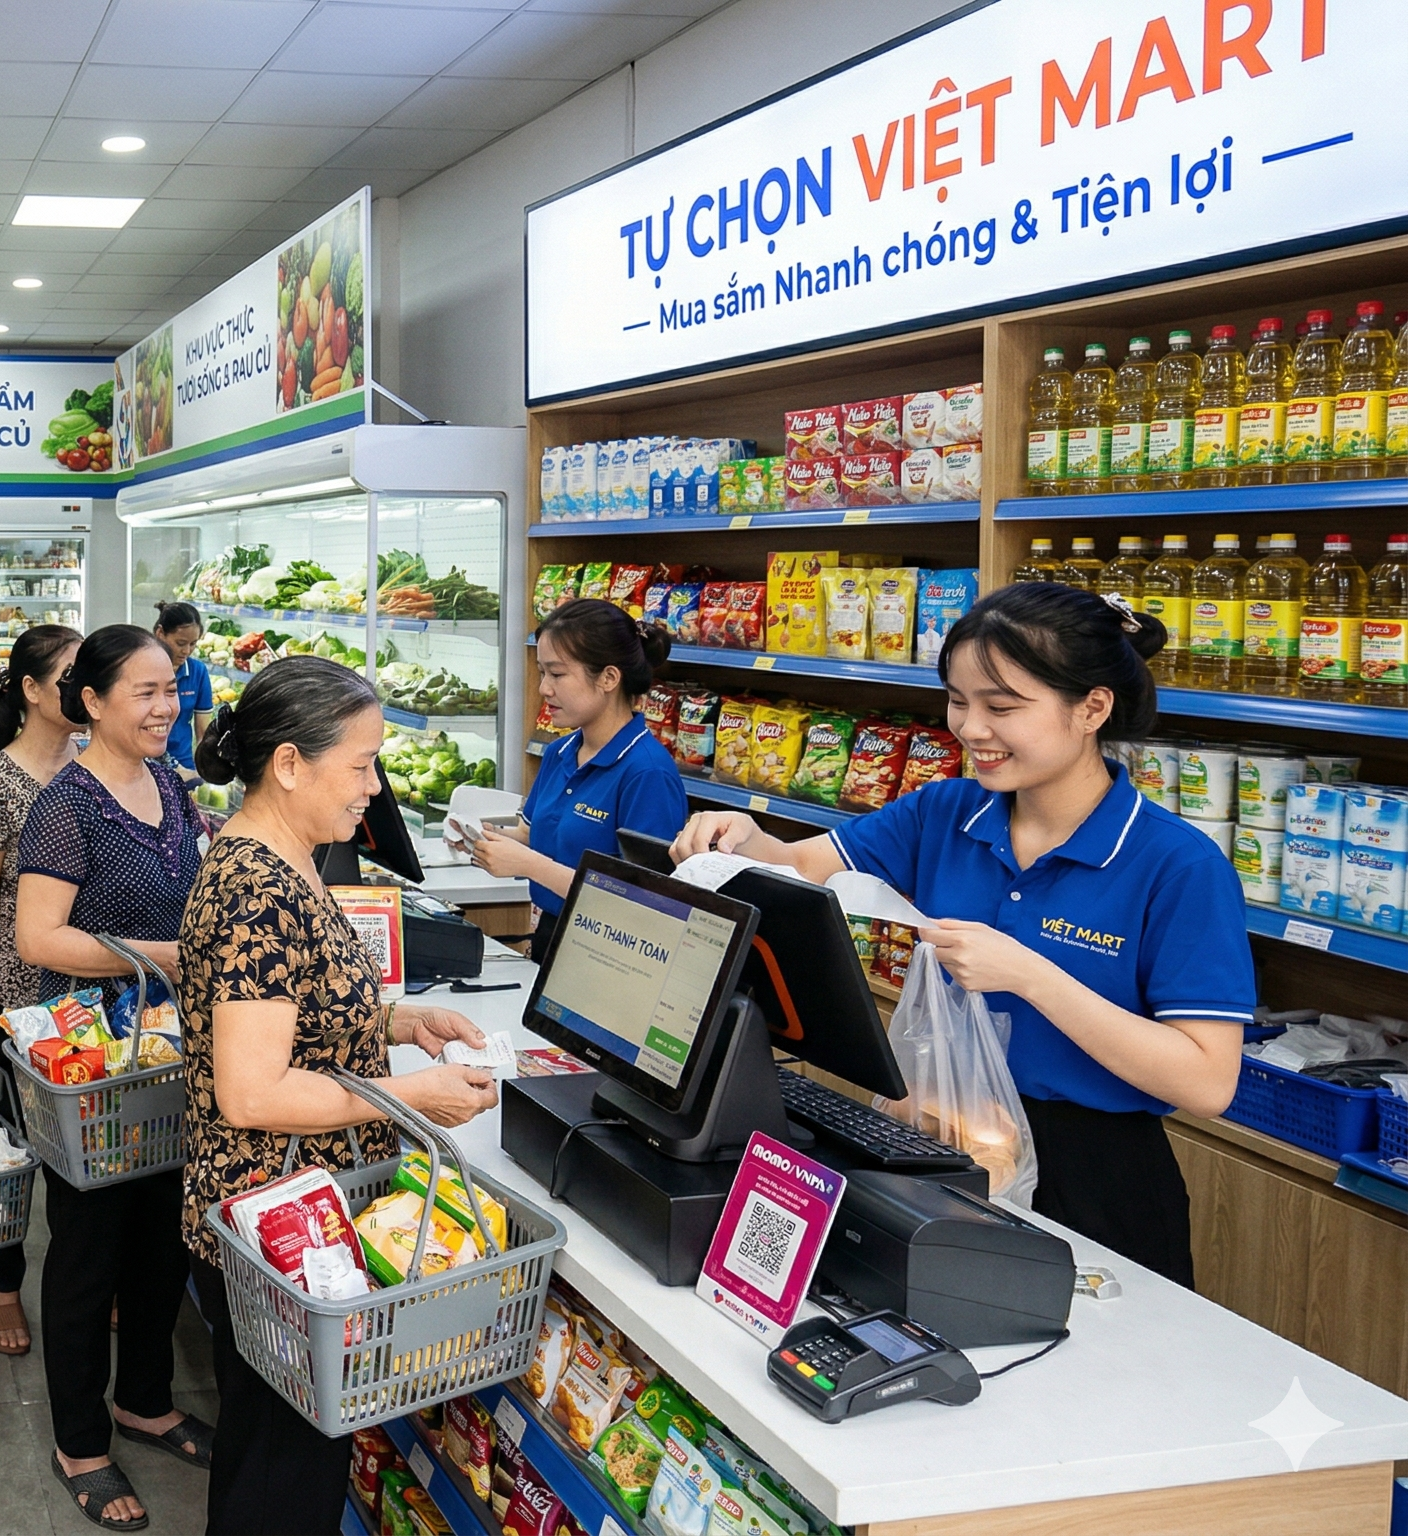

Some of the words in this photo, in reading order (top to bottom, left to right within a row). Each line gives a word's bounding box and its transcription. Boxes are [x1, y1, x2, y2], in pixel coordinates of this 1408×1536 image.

[620, 195, 675, 290] TỰ
[685, 145, 833, 254] CHỌN
[851, 76, 1013, 205] VIỆT
[659, 296, 707, 334] Mua
[713, 274, 766, 319] sắm
[774, 241, 872, 302] Nhanh
[881, 211, 997, 282] chóng
[1011, 197, 1039, 246] &
[1051, 172, 1152, 239] Tiện
[1171, 135, 1234, 212] lợi
[185, 335, 204, 366] KHU
[205, 321, 225, 359] VỰC
[226, 304, 254, 346] THỰC
[197, 362, 222, 399] SỐNG
[232, 351, 254, 384] RAU
[255, 333, 271, 374] CỦ
[603, 923, 638, 951] THANH
[1076, 927, 1126, 949] MART
